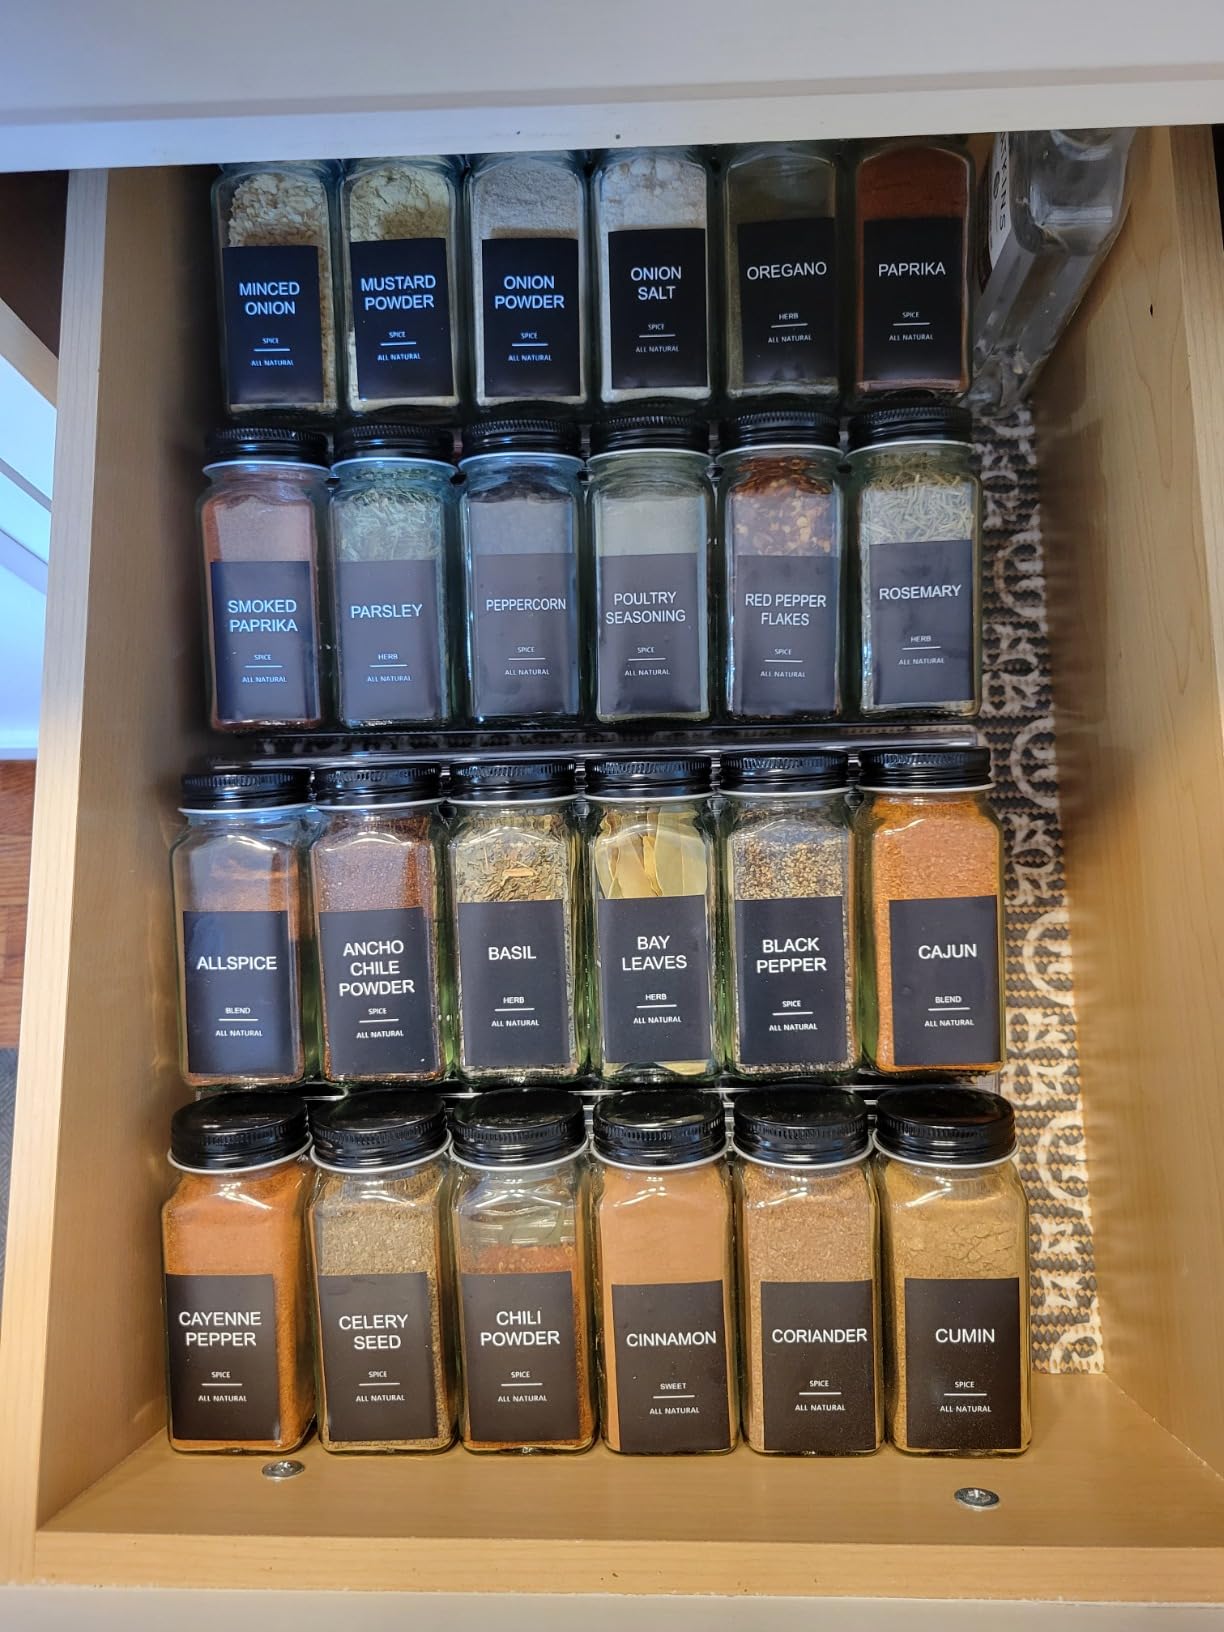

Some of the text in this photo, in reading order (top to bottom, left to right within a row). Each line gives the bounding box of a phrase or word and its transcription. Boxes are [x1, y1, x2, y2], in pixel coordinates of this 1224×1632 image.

[630, 265, 682, 282] ONION
[746, 261, 827, 281] OREGANO
[878, 261, 946, 277] PAPRIKA
[360, 274, 437, 292] MUSTARD
[503, 274, 555, 290] ONION
[238, 281, 301, 297] MINCED
[637, 285, 676, 301] SALT
[364, 293, 435, 311] POWDER
[494, 294, 565, 310] POWDER
[244, 300, 296, 316] ONION
[778, 312, 799, 321] HERB
[901, 311, 920, 319] SPICE
[647, 323, 665, 331] SPICE
[388, 330, 406, 339] SPICE
[520, 331, 538, 340] SPICE
[767, 334, 812, 344] ALL NATURAL
[902, 333, 934, 341] NATURAL
[261, 337, 280, 345] SPICE
[648, 345, 679, 353] NATURAL
[376, 352, 421, 362] ALL NATURAL
[507, 353, 552, 362] ALL NATURAL
[250, 359, 294, 367] ALL NATURAL
[879, 583, 962, 600] ROSEMARY
[613, 591, 677, 606] POULTRY
[744, 591, 827, 608] RED PEPPER
[227, 599, 297, 614] SMOKED
[486, 597, 567, 612] PEPPERCORN
[350, 603, 423, 619] PARSLEY
[605, 609, 686, 625] SEASONING
[761, 612, 810, 626] FLAKES
[229, 618, 299, 633] PAPRIKA
[910, 635, 932, 643] HERB
[637, 646, 655, 654] SPICE
[774, 648, 792, 656] SPICE
[377, 653, 399, 661] HERB
[898, 657, 945, 666] ALL NATURAL
[518, 668, 550, 676] NATURAL
[255, 675, 288, 683] NATURAL
[366, 675, 379, 683] ALL
[342, 939, 405, 957] ANCHO
[637, 935, 671, 951] BAY
[762, 937, 820, 954] BLACK
[488, 945, 537, 961] BASIL
[918, 943, 978, 960] CAJUN
[196, 955, 278, 971] ALLSPICE
[621, 954, 688, 972] LEAVES
[756, 957, 828, 974] PEPPER
[349, 960, 401, 977] CHILE
[338, 979, 416, 997] POWDER
[502, 996, 525, 1004] HERB
[645, 993, 668, 1001] HERB
[934, 995, 963, 1004] BLEND
[781, 999, 802, 1008] SPICE
[224, 1007, 251, 1015] BLEND
[367, 1007, 387, 1015] SPICE
[490, 1019, 540, 1028] ALL NATURAL
[633, 1015, 682, 1025] ALL NATURAL
[924, 1018, 975, 1028] ALL NATURAL
[768, 1022, 818, 1032] ALL NATURAL
[215, 1029, 263, 1037] ALL NATURAL
[356, 1029, 405, 1039] ALL NATURAL
[178, 1311, 262, 1327] CAYENNE
[338, 1313, 409, 1331] CELERY
[496, 1310, 542, 1326] CHILI
[185, 1331, 257, 1347] PEPPER
[480, 1330, 561, 1347] POWDER
[626, 1330, 717, 1348] CINNAMON
[771, 1327, 868, 1344] CORIANDER
[935, 1328, 995, 1344] CUMIN
[353, 1334, 402, 1351] SEED
[211, 1371, 231, 1379] SPICE
[368, 1370, 388, 1378] SPICE
[510, 1370, 531, 1379] SPICE
[659, 1382, 687, 1390] SWEET
[809, 1379, 830, 1388] SPICE
[954, 1380, 975, 1389] SPICE
[197, 1394, 211, 1402] ALL
[355, 1394, 406, 1403] ALL NATURAL
[497, 1394, 548, 1403] ALL NATURAL
[649, 1406, 700, 1415] ALL NATURAL
[794, 1404, 846, 1412] ALL NATURAL
[939, 1404, 992, 1413] ALL NATURAL
